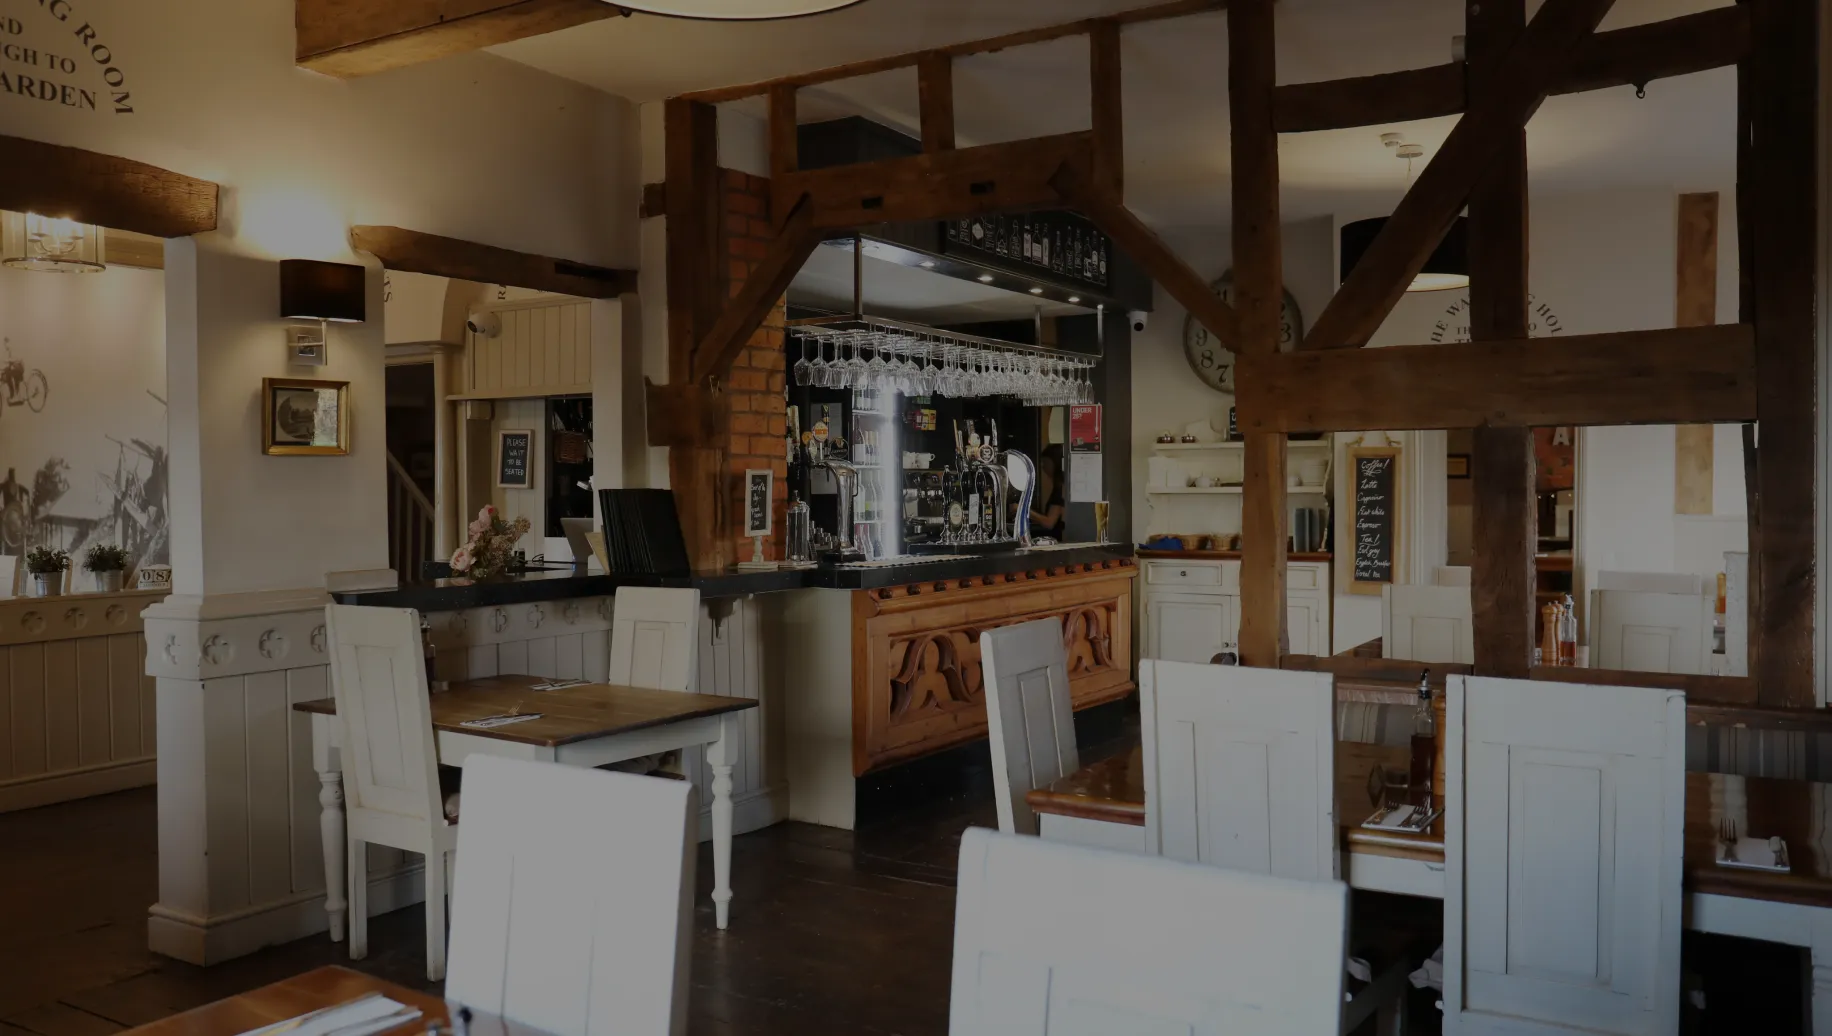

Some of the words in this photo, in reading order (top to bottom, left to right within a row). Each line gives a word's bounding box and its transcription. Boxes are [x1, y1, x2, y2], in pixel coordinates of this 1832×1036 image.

[0, 43, 37, 66] GH
[45, 53, 76, 75] TO
[74, 21, 134, 116] ROOM
[1195, 328, 1208, 347] 9
[1431, 320, 1449, 343] HE
[1200, 349, 1214, 369] 8
[1215, 364, 1229, 384] 7
[506, 438, 527, 447] PLEASE
[508, 449, 525, 457] WAIT
[504, 468, 525, 476] SEATED
[1360, 478, 1379, 489] Latte
